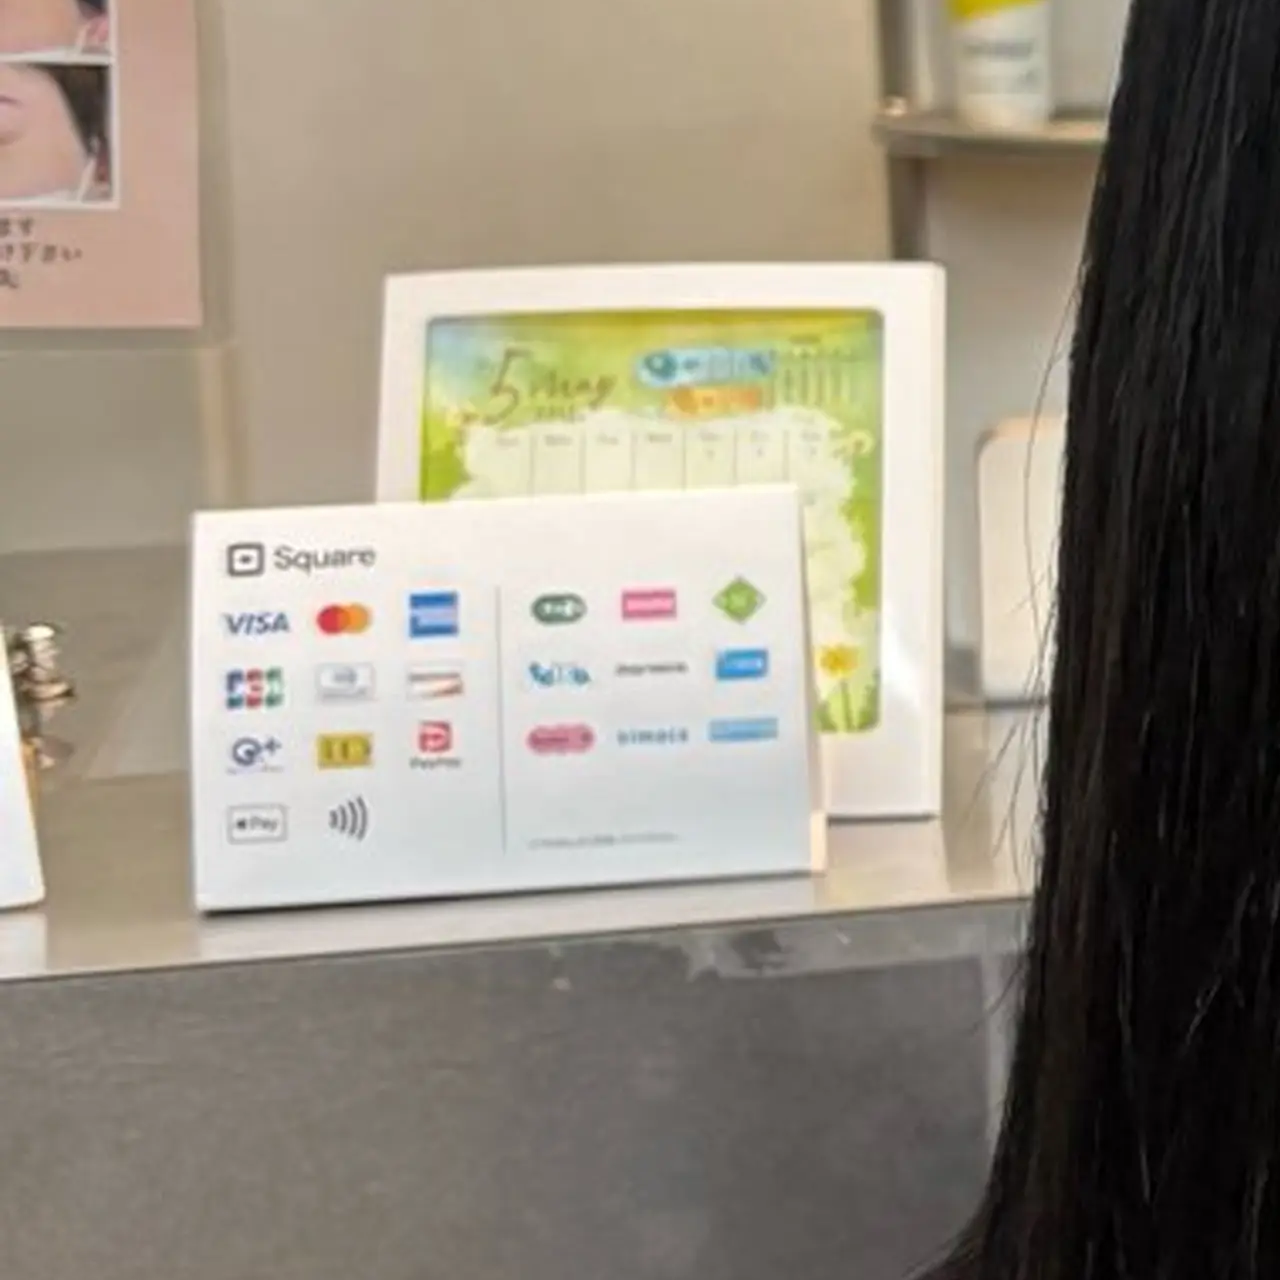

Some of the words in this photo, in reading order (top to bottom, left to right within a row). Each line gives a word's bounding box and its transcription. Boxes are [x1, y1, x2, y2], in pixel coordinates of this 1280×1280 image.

[483, 347, 533, 426] 5
[273, 544, 377, 574] Square
[223, 611, 291, 636] VISA
